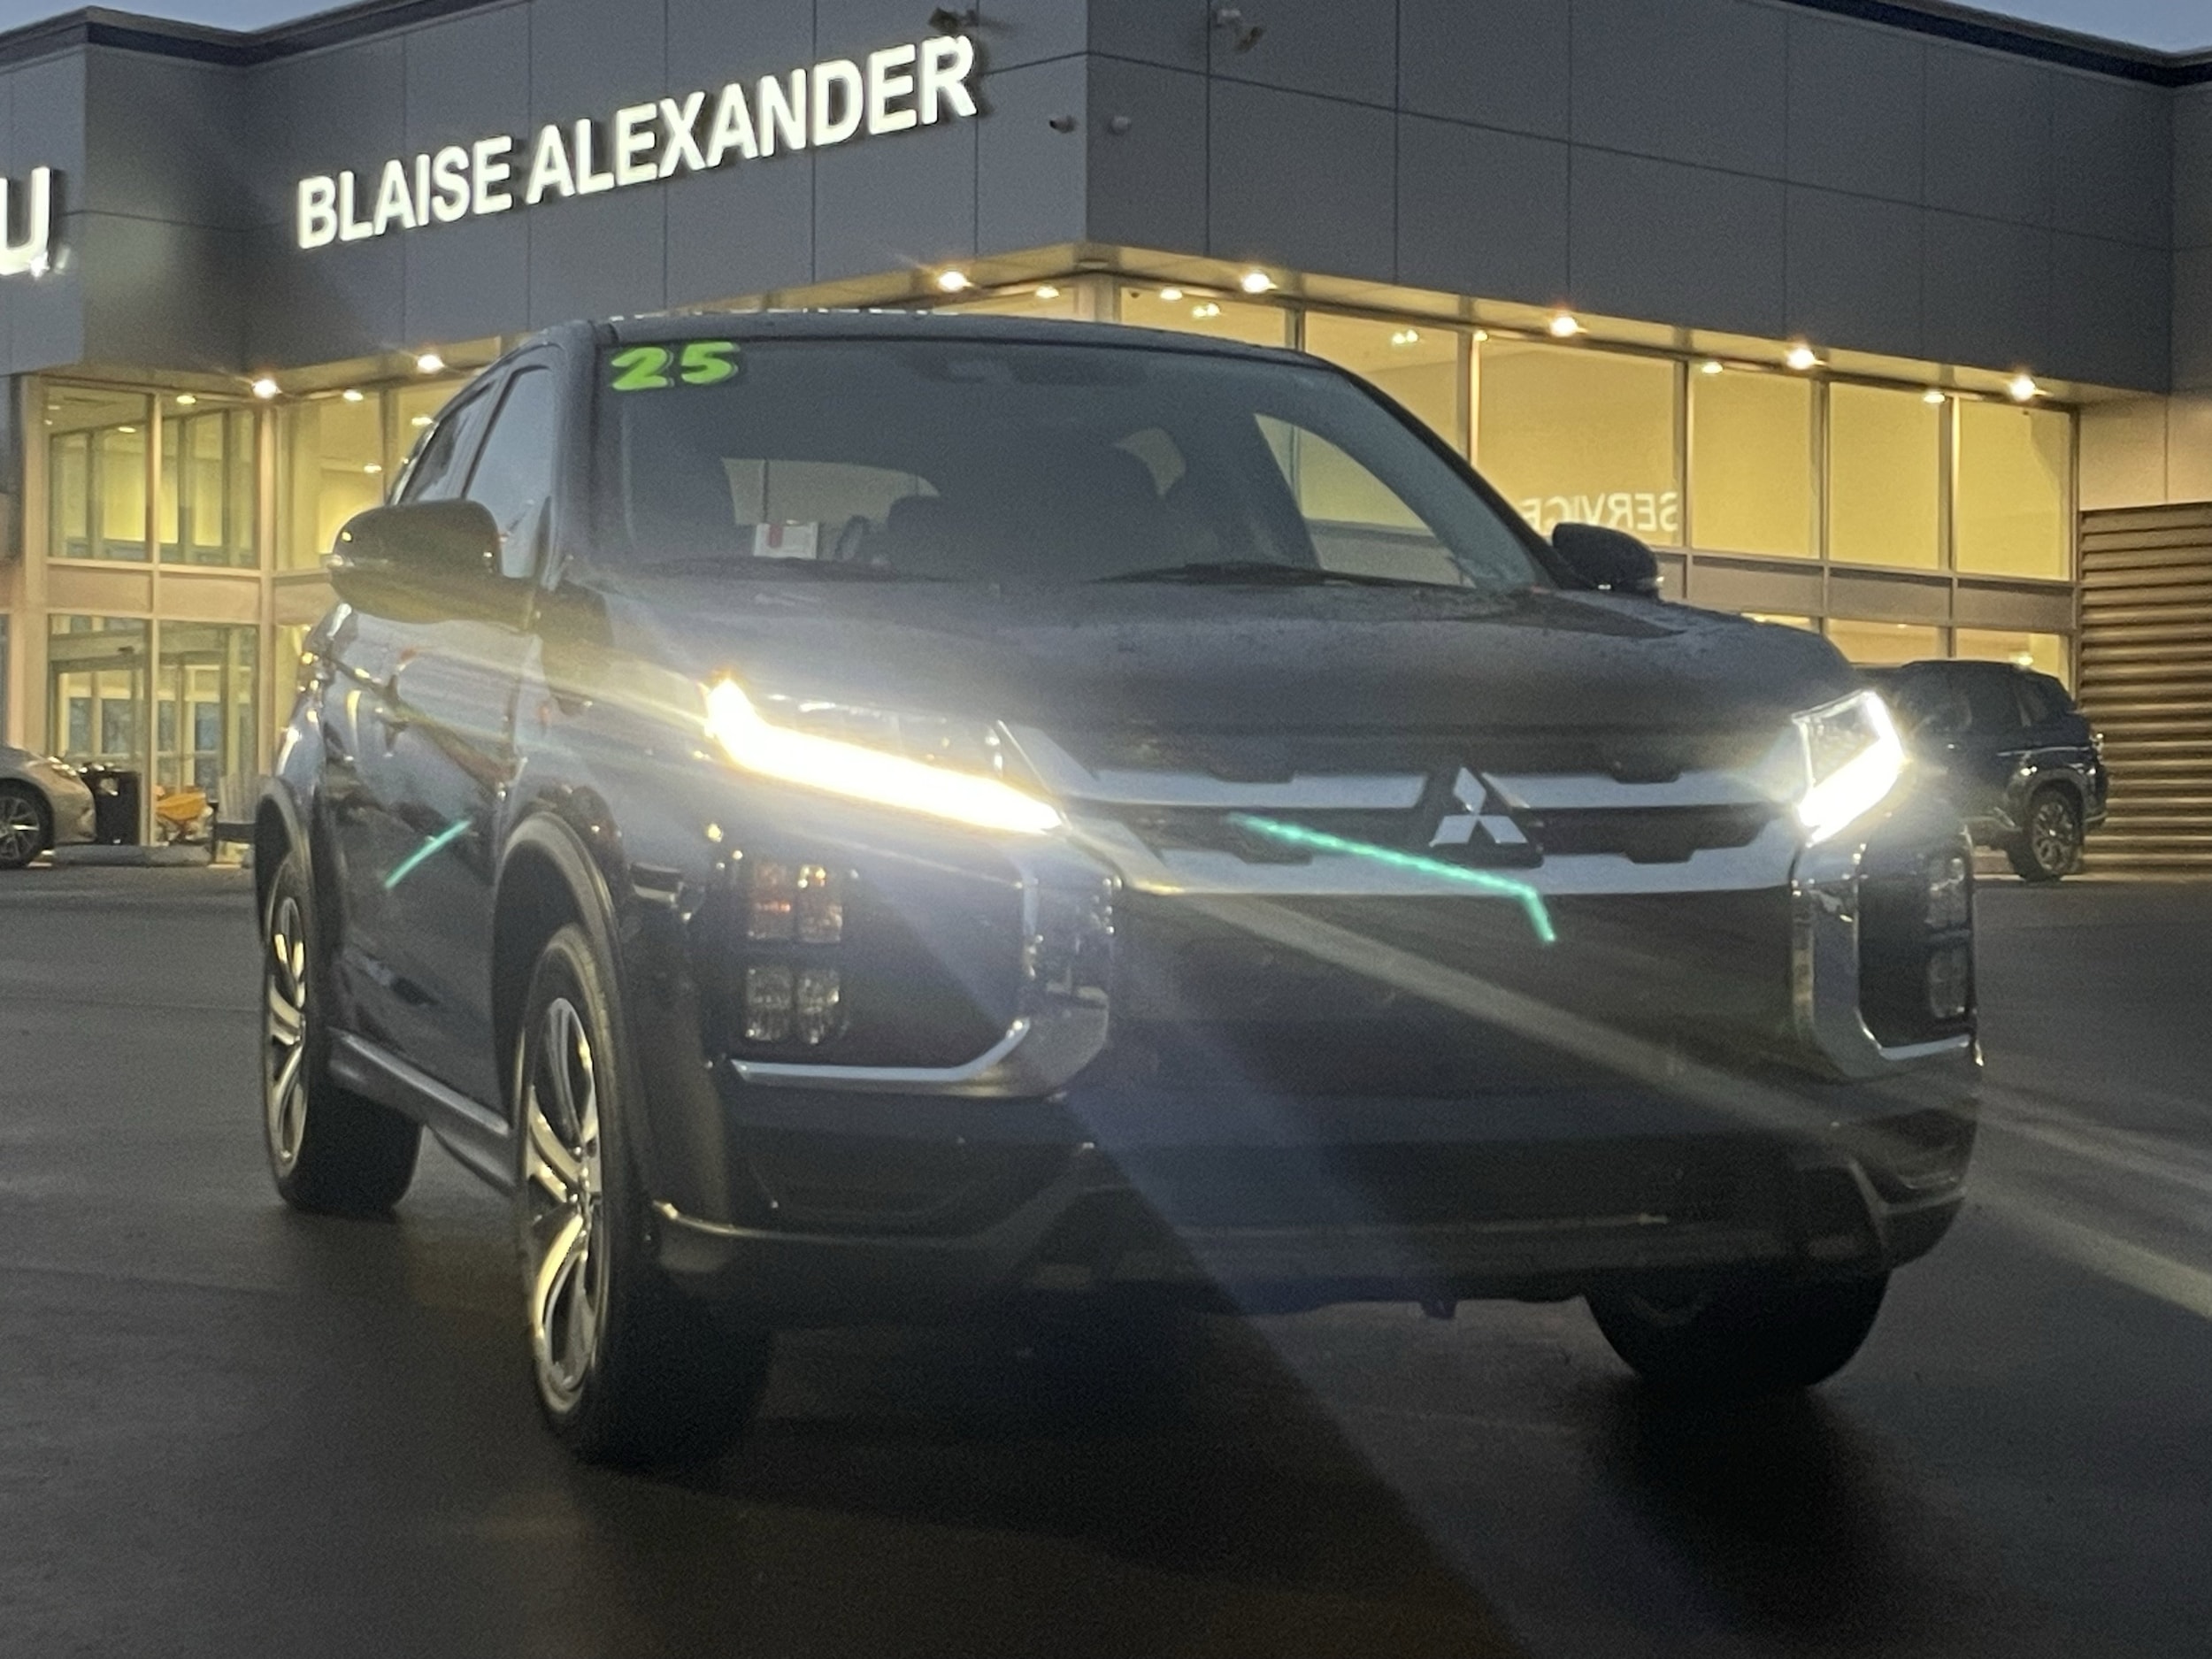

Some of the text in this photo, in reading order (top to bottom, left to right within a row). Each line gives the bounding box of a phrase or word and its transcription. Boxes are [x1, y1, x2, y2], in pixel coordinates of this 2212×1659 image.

[297, 35, 978, 250] BLAISE ALEXANDER
[611, 341, 740, 390] 25
